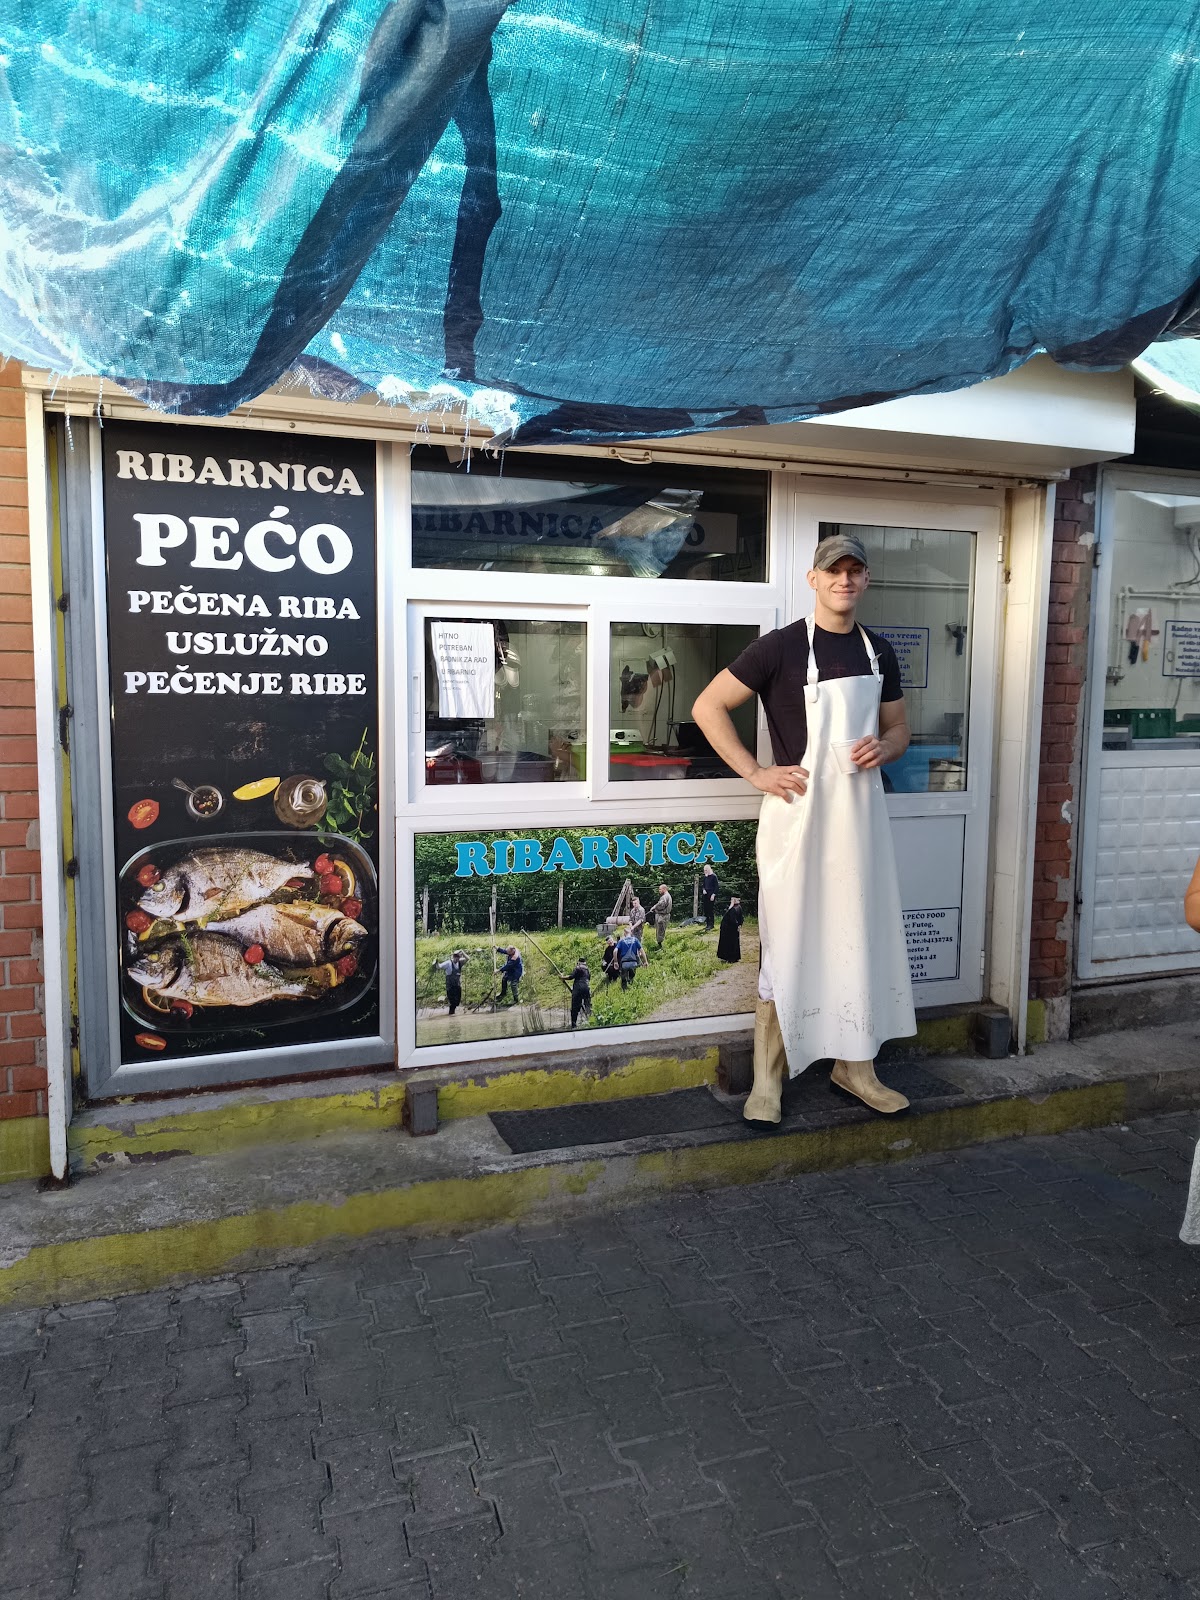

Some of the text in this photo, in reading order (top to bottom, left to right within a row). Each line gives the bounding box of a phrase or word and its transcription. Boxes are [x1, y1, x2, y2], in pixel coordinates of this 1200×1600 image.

[116, 450, 365, 497] RIBARNICA
[132, 505, 354, 576] PEĆO
[126, 584, 361, 620] PEČENA RIBA
[165, 627, 329, 657] USLUŽNO
[438, 632, 460, 640] HITNO
[439, 644, 474, 652] POTREBAN
[473, 656, 488, 664] RAD
[123, 664, 367, 696] PEČENJE RIBE
[454, 830, 730, 878] RIBARNICA
[926, 911, 946, 919] FOOD
